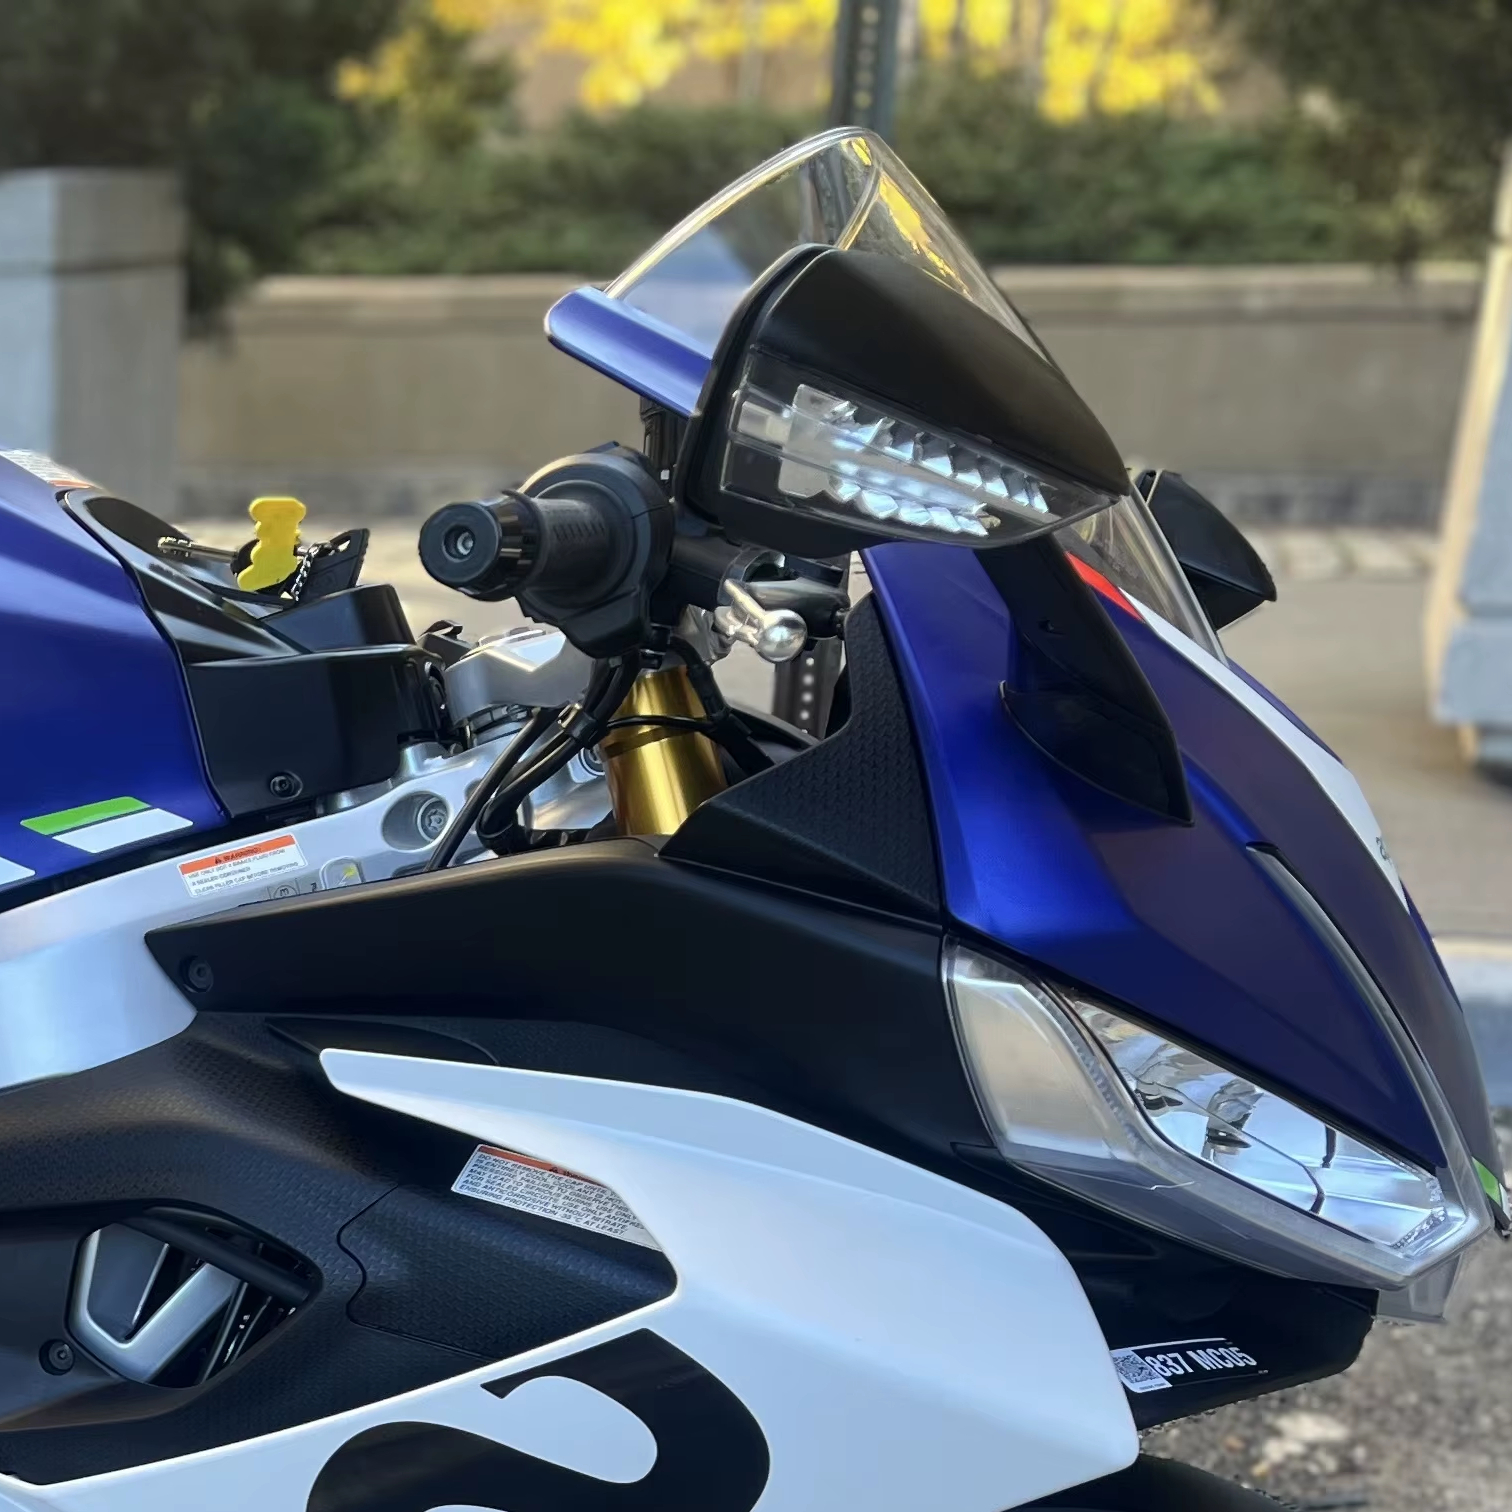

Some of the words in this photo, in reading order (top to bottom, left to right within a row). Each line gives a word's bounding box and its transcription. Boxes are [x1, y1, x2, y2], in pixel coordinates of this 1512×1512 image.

[492, 1157, 509, 1165] NOT
[564, 1178, 583, 1186] CAP
[462, 1178, 481, 1186] AND
[551, 1204, 590, 1218] WITHOUT
[465, 1173, 484, 1181] FOR
[561, 1201, 579, 1209] USE
[580, 1206, 604, 1216] ONLY
[503, 1197, 558, 1216] PROTECTION
